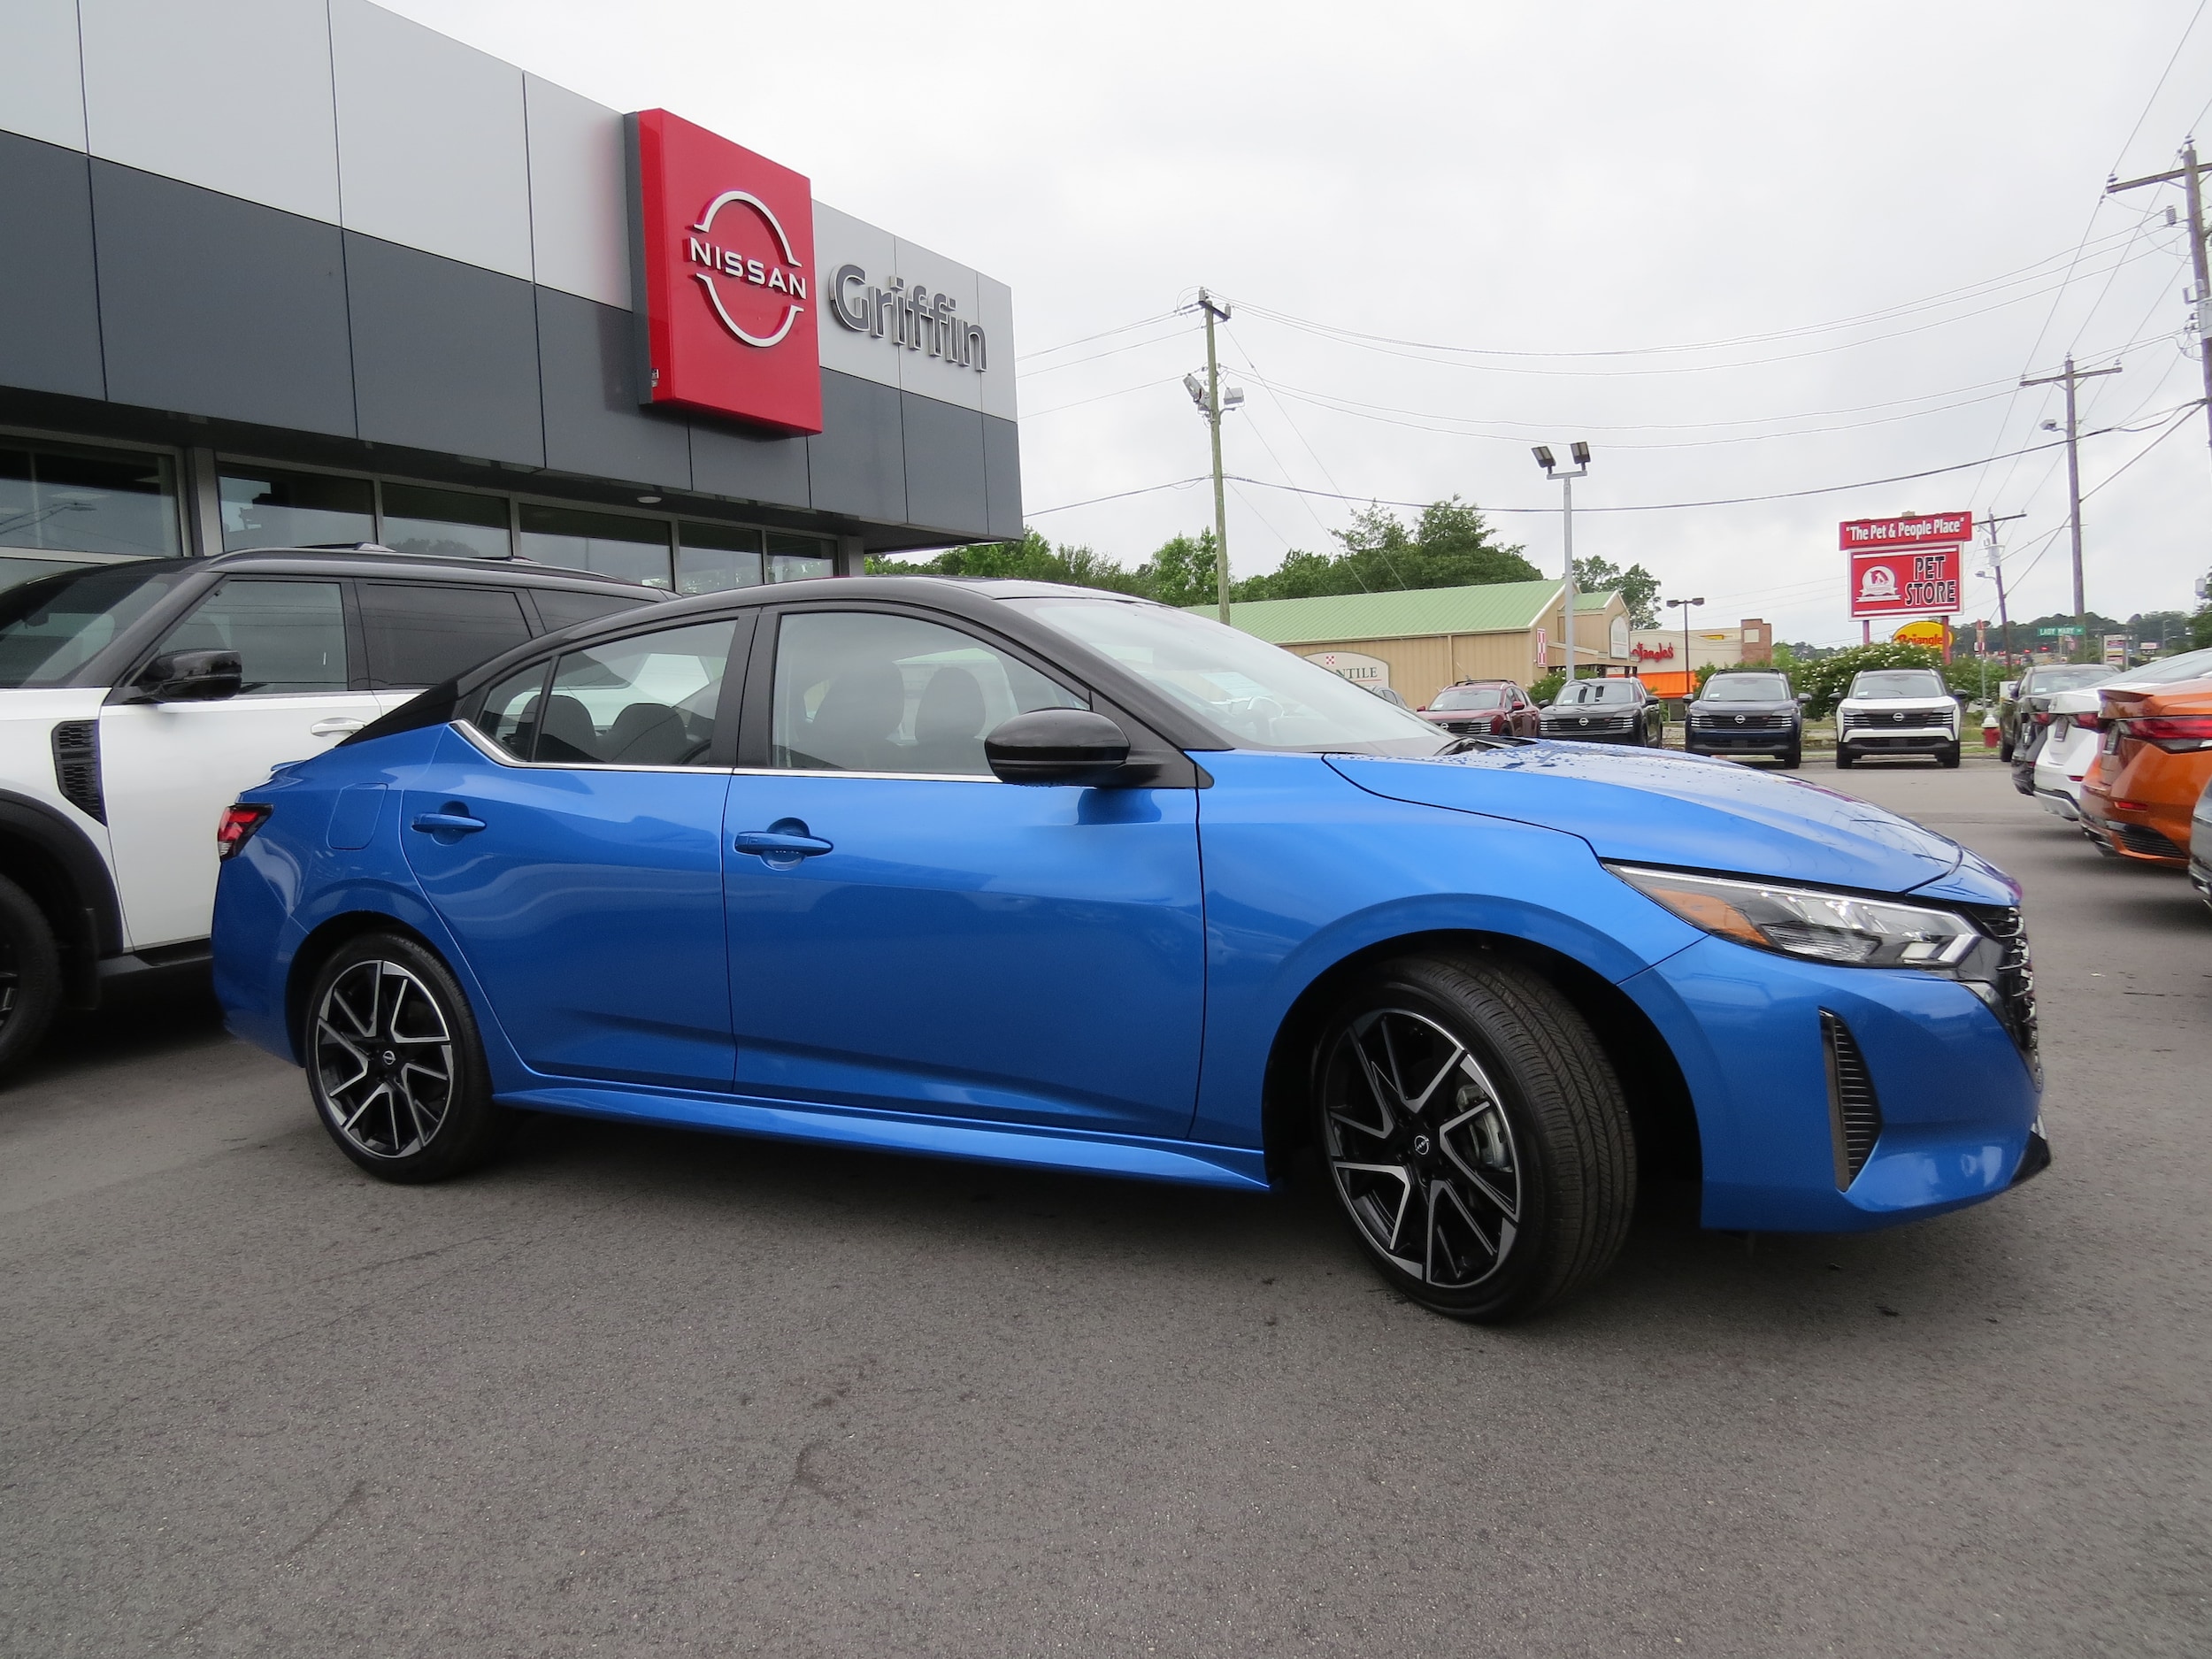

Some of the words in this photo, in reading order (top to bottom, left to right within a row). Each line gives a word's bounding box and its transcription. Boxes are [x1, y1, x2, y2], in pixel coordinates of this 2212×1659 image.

[688, 236, 806, 299] NISSAN
[830, 264, 987, 373] Griffin
[1870, 524, 1886, 539] Pet
[1888, 522, 1896, 538] &
[1898, 520, 1932, 540] People
[1914, 555, 1946, 580] PET
[1905, 580, 1956, 606] STORE
[1336, 667, 1378, 679] NTILE
